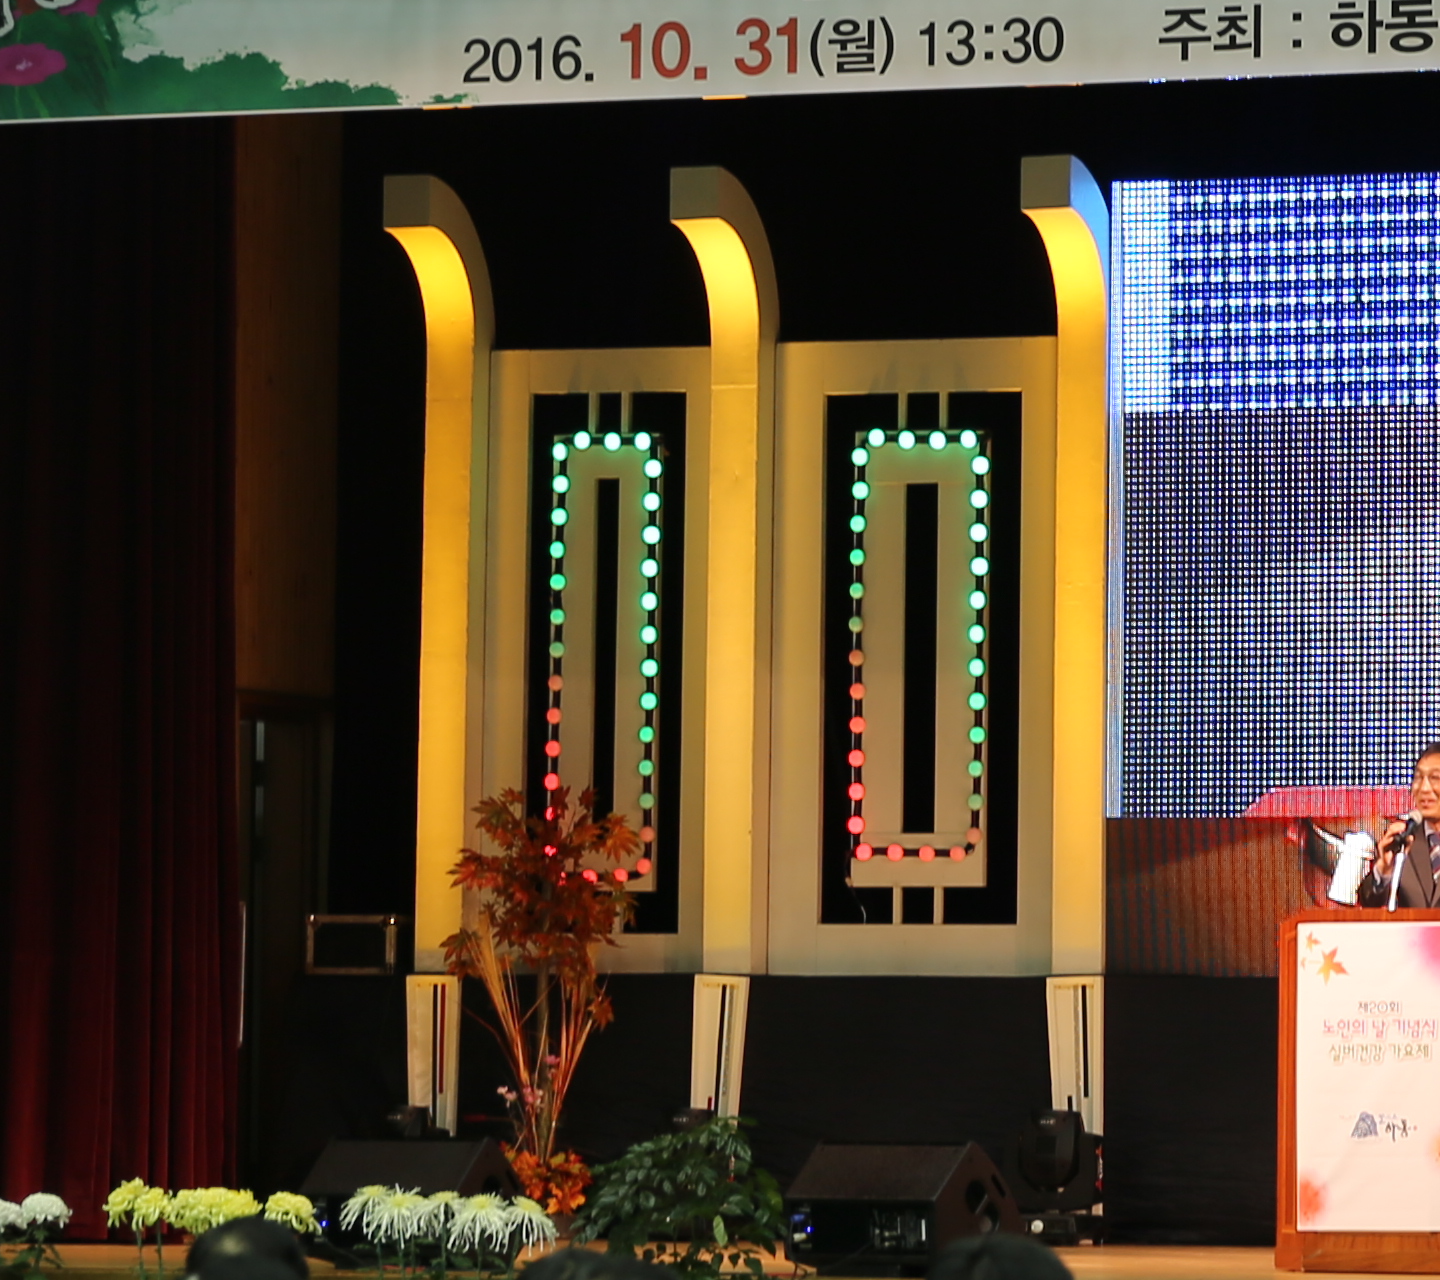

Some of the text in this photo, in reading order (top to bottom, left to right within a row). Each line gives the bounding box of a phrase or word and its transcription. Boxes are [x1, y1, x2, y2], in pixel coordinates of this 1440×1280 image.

[464, 34, 595, 84] 2016.
[621, 21, 708, 81] 10.
[735, 16, 895, 77] 31(월)
[921, 16, 1064, 65] 13:30
[1158, 2, 1265, 61] 주최
[1358, 1001, 1400, 1014] 제20회
[1323, 1019, 1436, 1039] 노인의 날 기념식
[1391, 1044, 1430, 1058] 가요제
